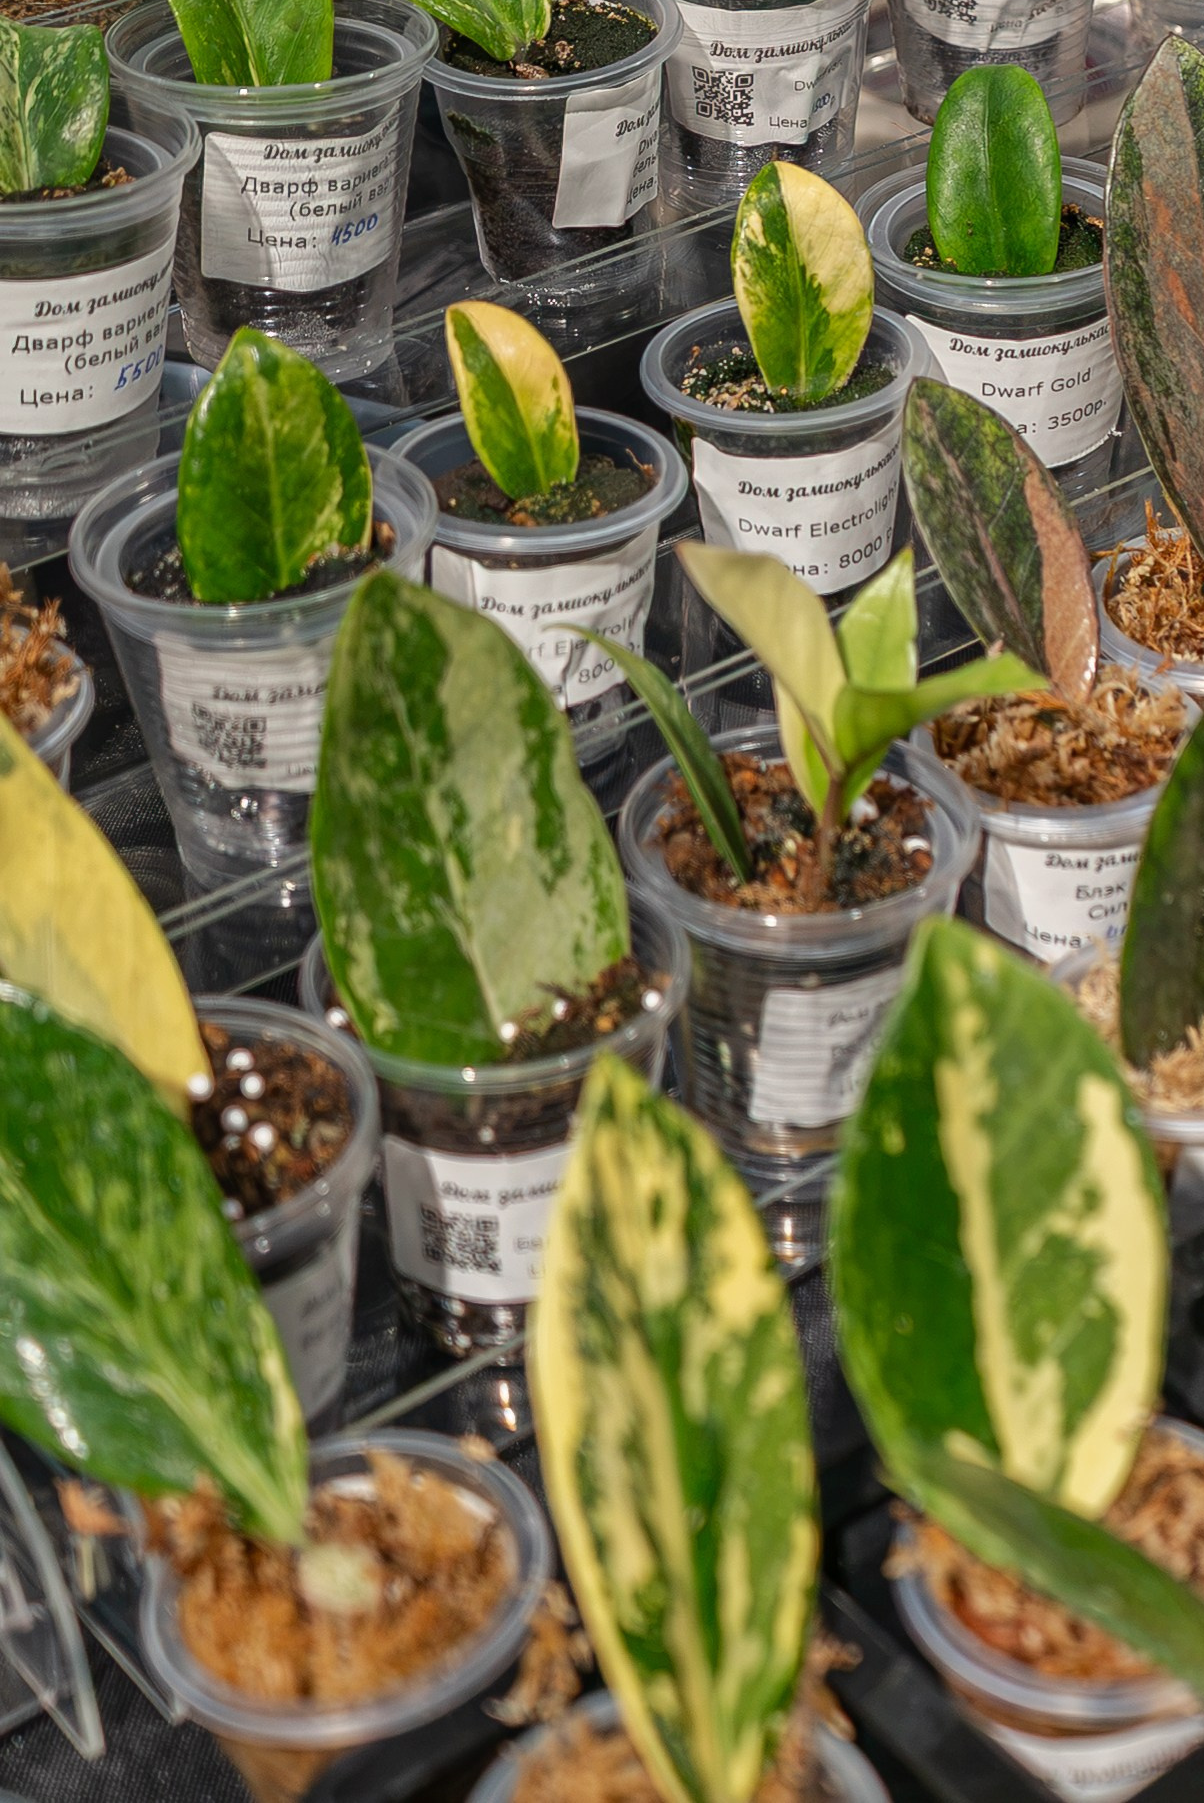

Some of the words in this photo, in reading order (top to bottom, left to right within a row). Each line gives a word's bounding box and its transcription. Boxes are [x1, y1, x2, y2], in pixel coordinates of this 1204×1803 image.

[709, 41, 751, 59] Дом
[263, 144, 309, 160] Дом
[241, 176, 319, 197] Дварф
[289, 191, 363, 222] (белый
[247, 227, 317, 249] Цена:
[331, 212, 379, 246] 4500
[34, 300, 81, 318] Дом
[11, 329, 94, 355] Дварф
[949, 337, 991, 358] Дом
[64, 337, 140, 376] (белый
[981, 381, 1045, 398] Dwarf
[1050, 367, 1092, 393] Gold
[20, 385, 94, 409] Цена:
[738, 480, 781, 498] Дом
[738, 517, 803, 539] Dwarf
[785, 562, 829, 577] на:
[838, 536, 883, 570] 8000
[480, 596, 525, 617] Дом
[578, 657, 616, 684] 800
[1076, 881, 1126, 900] Блэк
